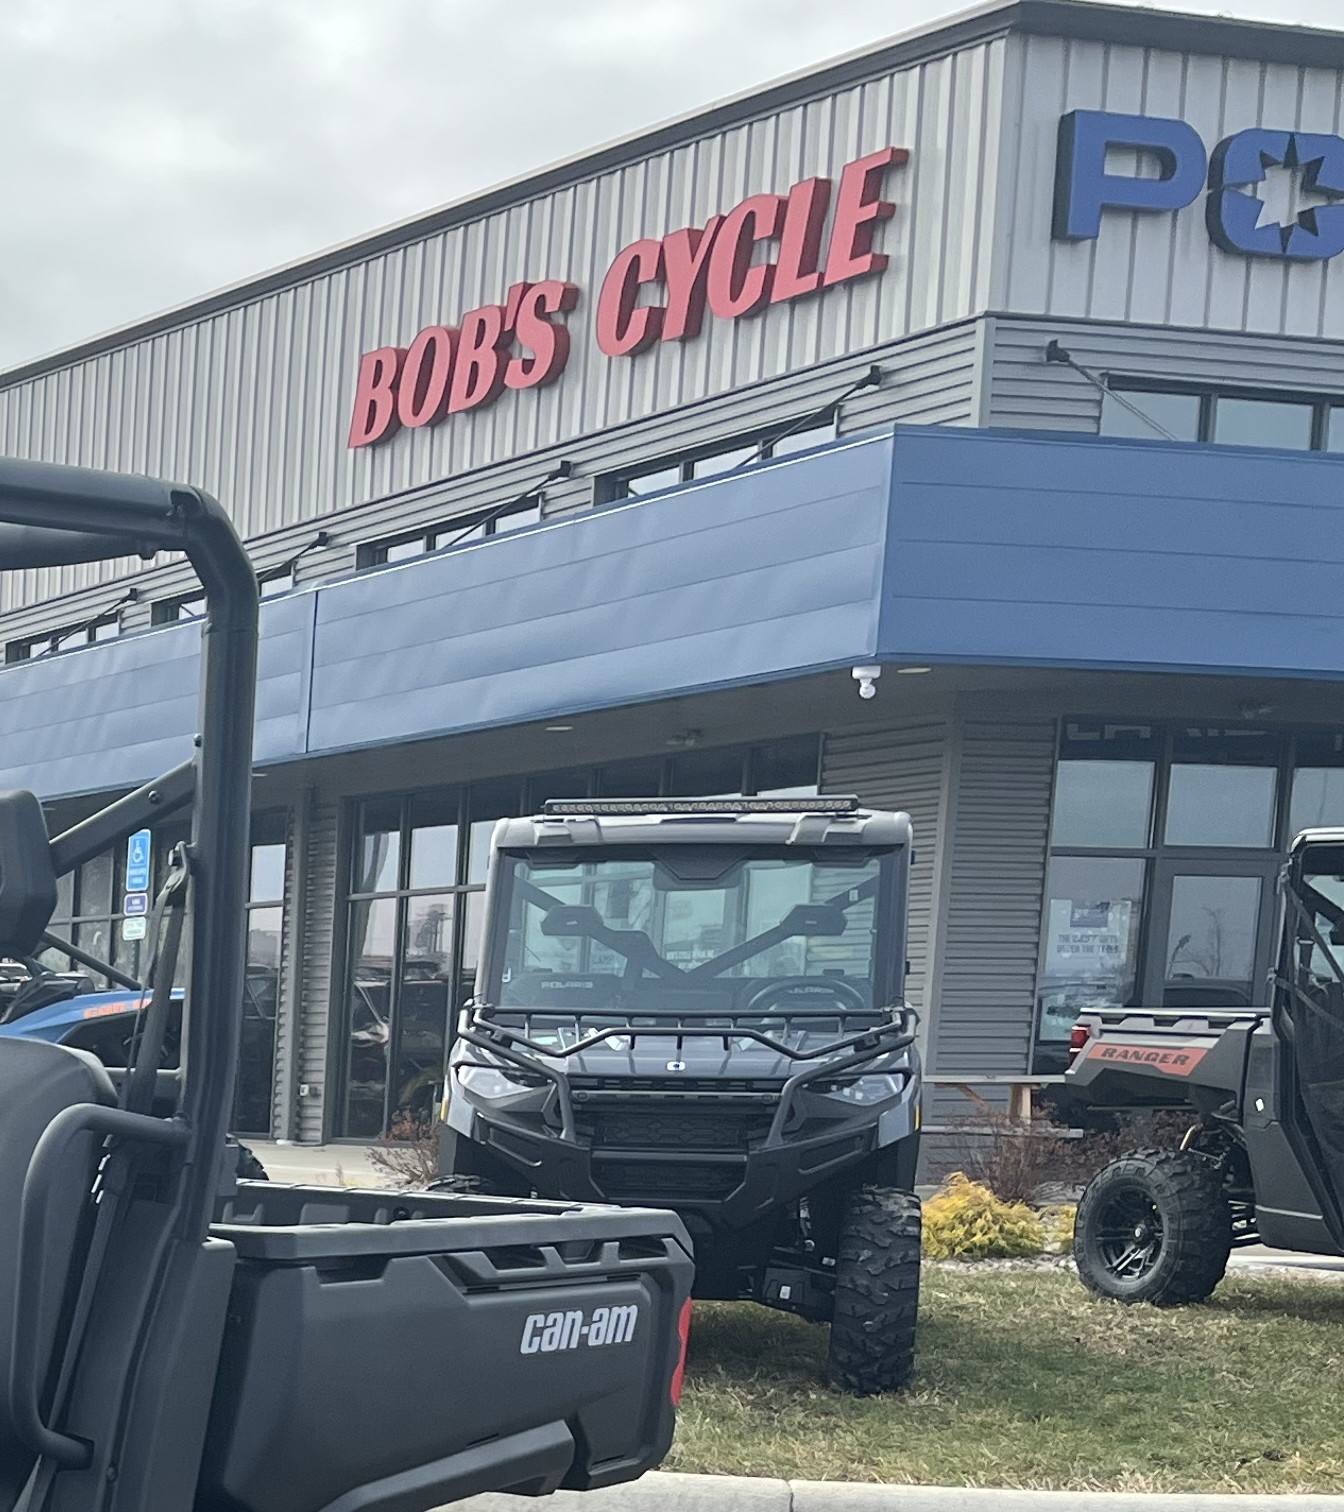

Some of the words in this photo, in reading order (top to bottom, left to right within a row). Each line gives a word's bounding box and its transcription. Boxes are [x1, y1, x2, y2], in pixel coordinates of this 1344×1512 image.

[347, 280, 577, 449] BOB'S
[596, 147, 906, 357] CYCLE
[1101, 1047, 1190, 1066] RANGER
[520, 1304, 638, 1355] can-am
